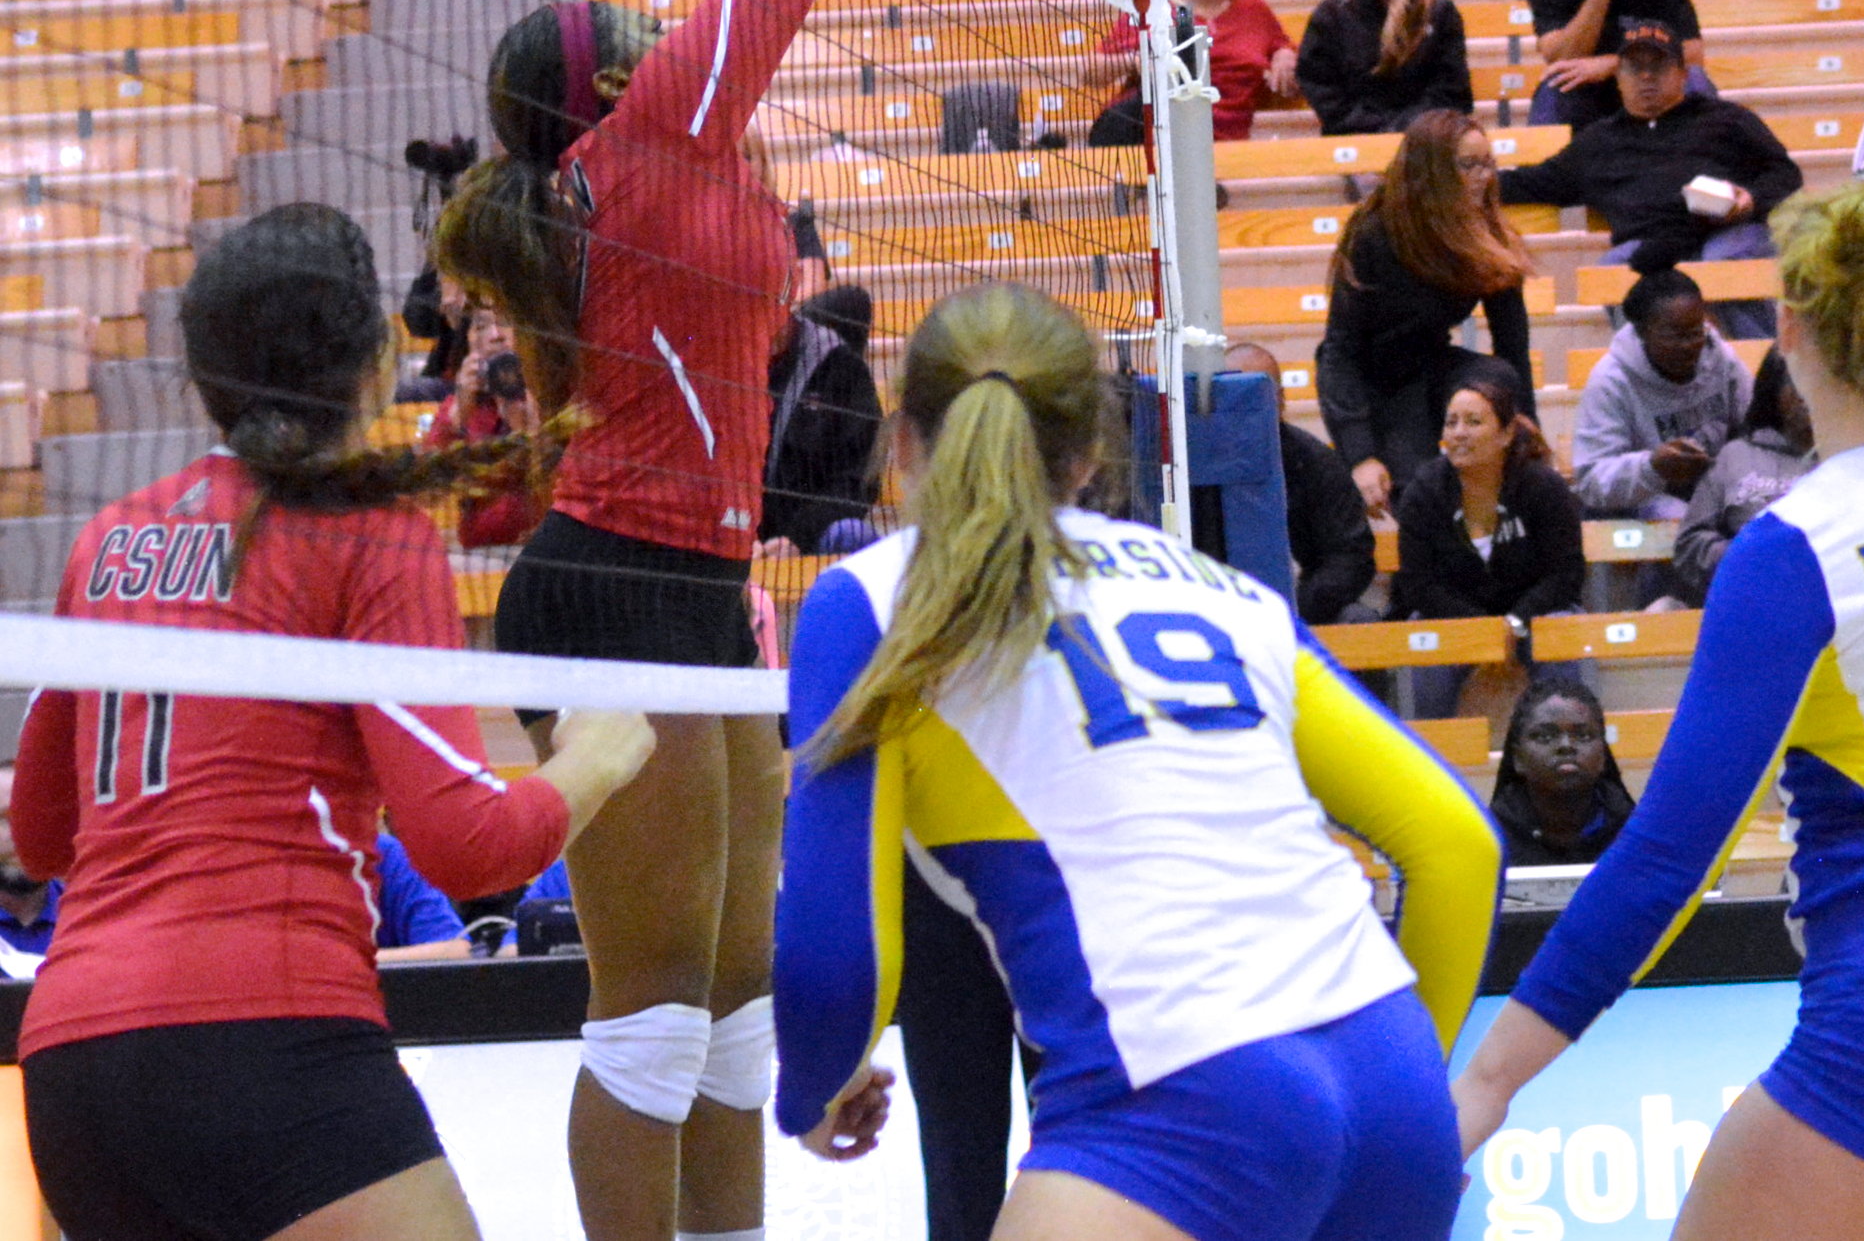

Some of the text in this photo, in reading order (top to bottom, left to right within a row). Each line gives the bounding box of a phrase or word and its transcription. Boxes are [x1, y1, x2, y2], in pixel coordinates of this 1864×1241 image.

[86, 523, 236, 602] CSUN
[1045, 611, 1267, 750] 19
[94, 687, 175, 805] 11
